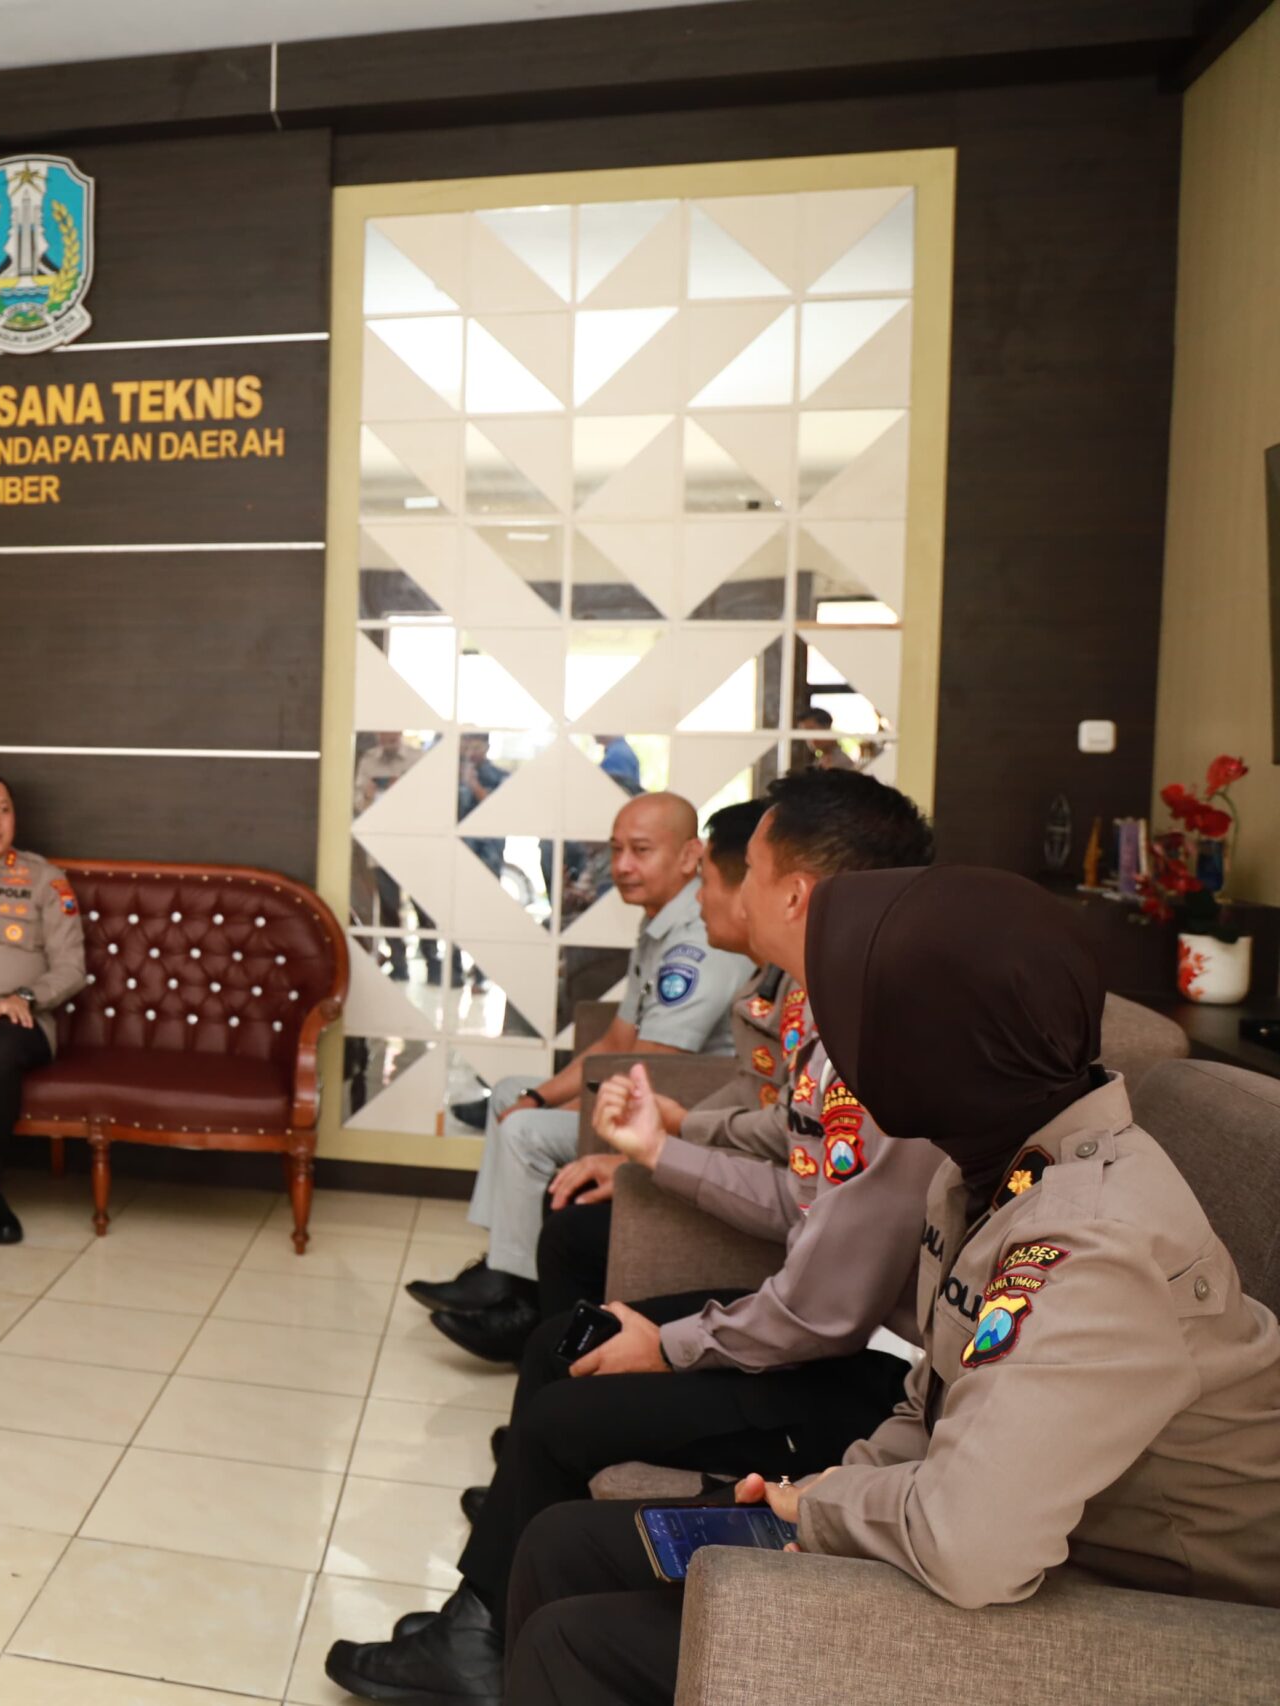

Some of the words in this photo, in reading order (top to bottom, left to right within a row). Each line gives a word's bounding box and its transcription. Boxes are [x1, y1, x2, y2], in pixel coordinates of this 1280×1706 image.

[112, 375, 263, 424] TEKNIS
[159, 428, 285, 461] DAERAH
[1009, 1276, 1042, 1290] TIMUR
